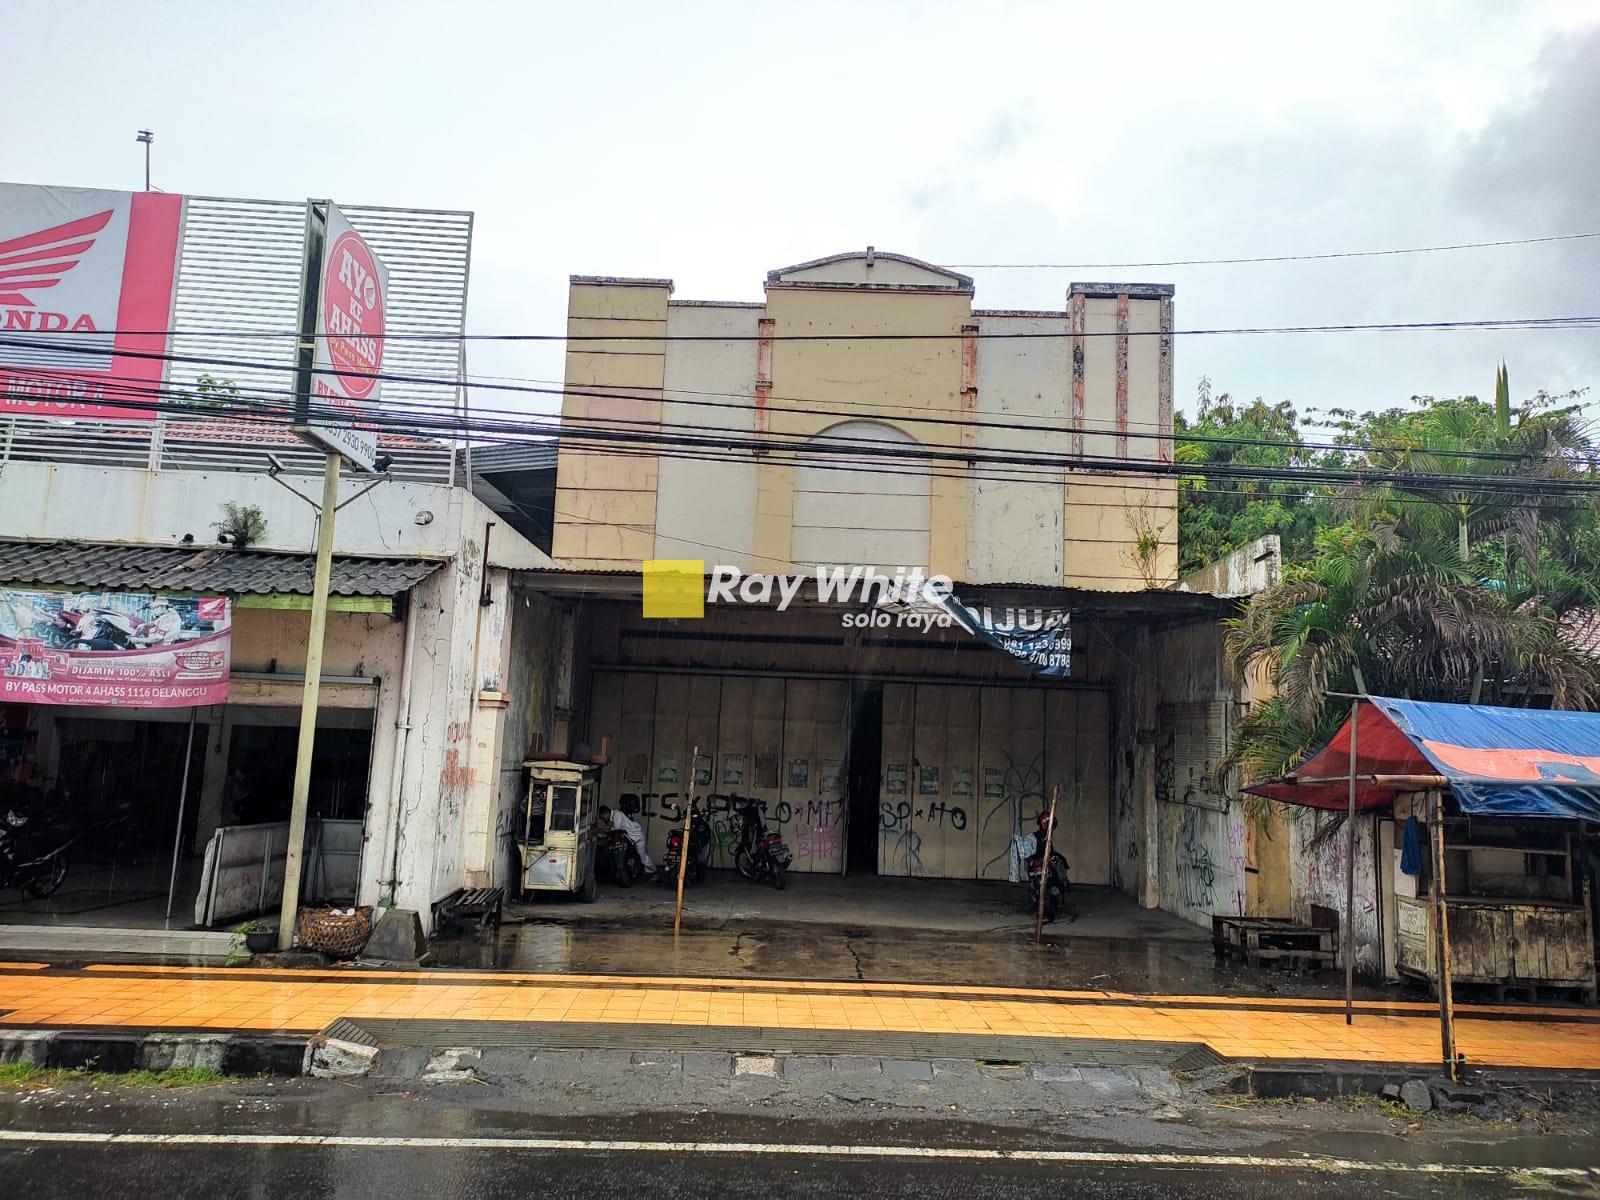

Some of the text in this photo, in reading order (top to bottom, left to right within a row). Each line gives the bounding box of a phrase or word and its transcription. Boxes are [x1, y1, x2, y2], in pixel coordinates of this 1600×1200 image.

[349, 296, 363, 323] KE
[330, 303, 377, 366] AHASS
[71, 666, 114, 676] DIJAMIN
[119, 668, 146, 677] 100%
[149, 669, 171, 679] ASLI
[5, 681, 208, 698] BY PASS MOTOR 4 AHASS 1116 DELANGGU
